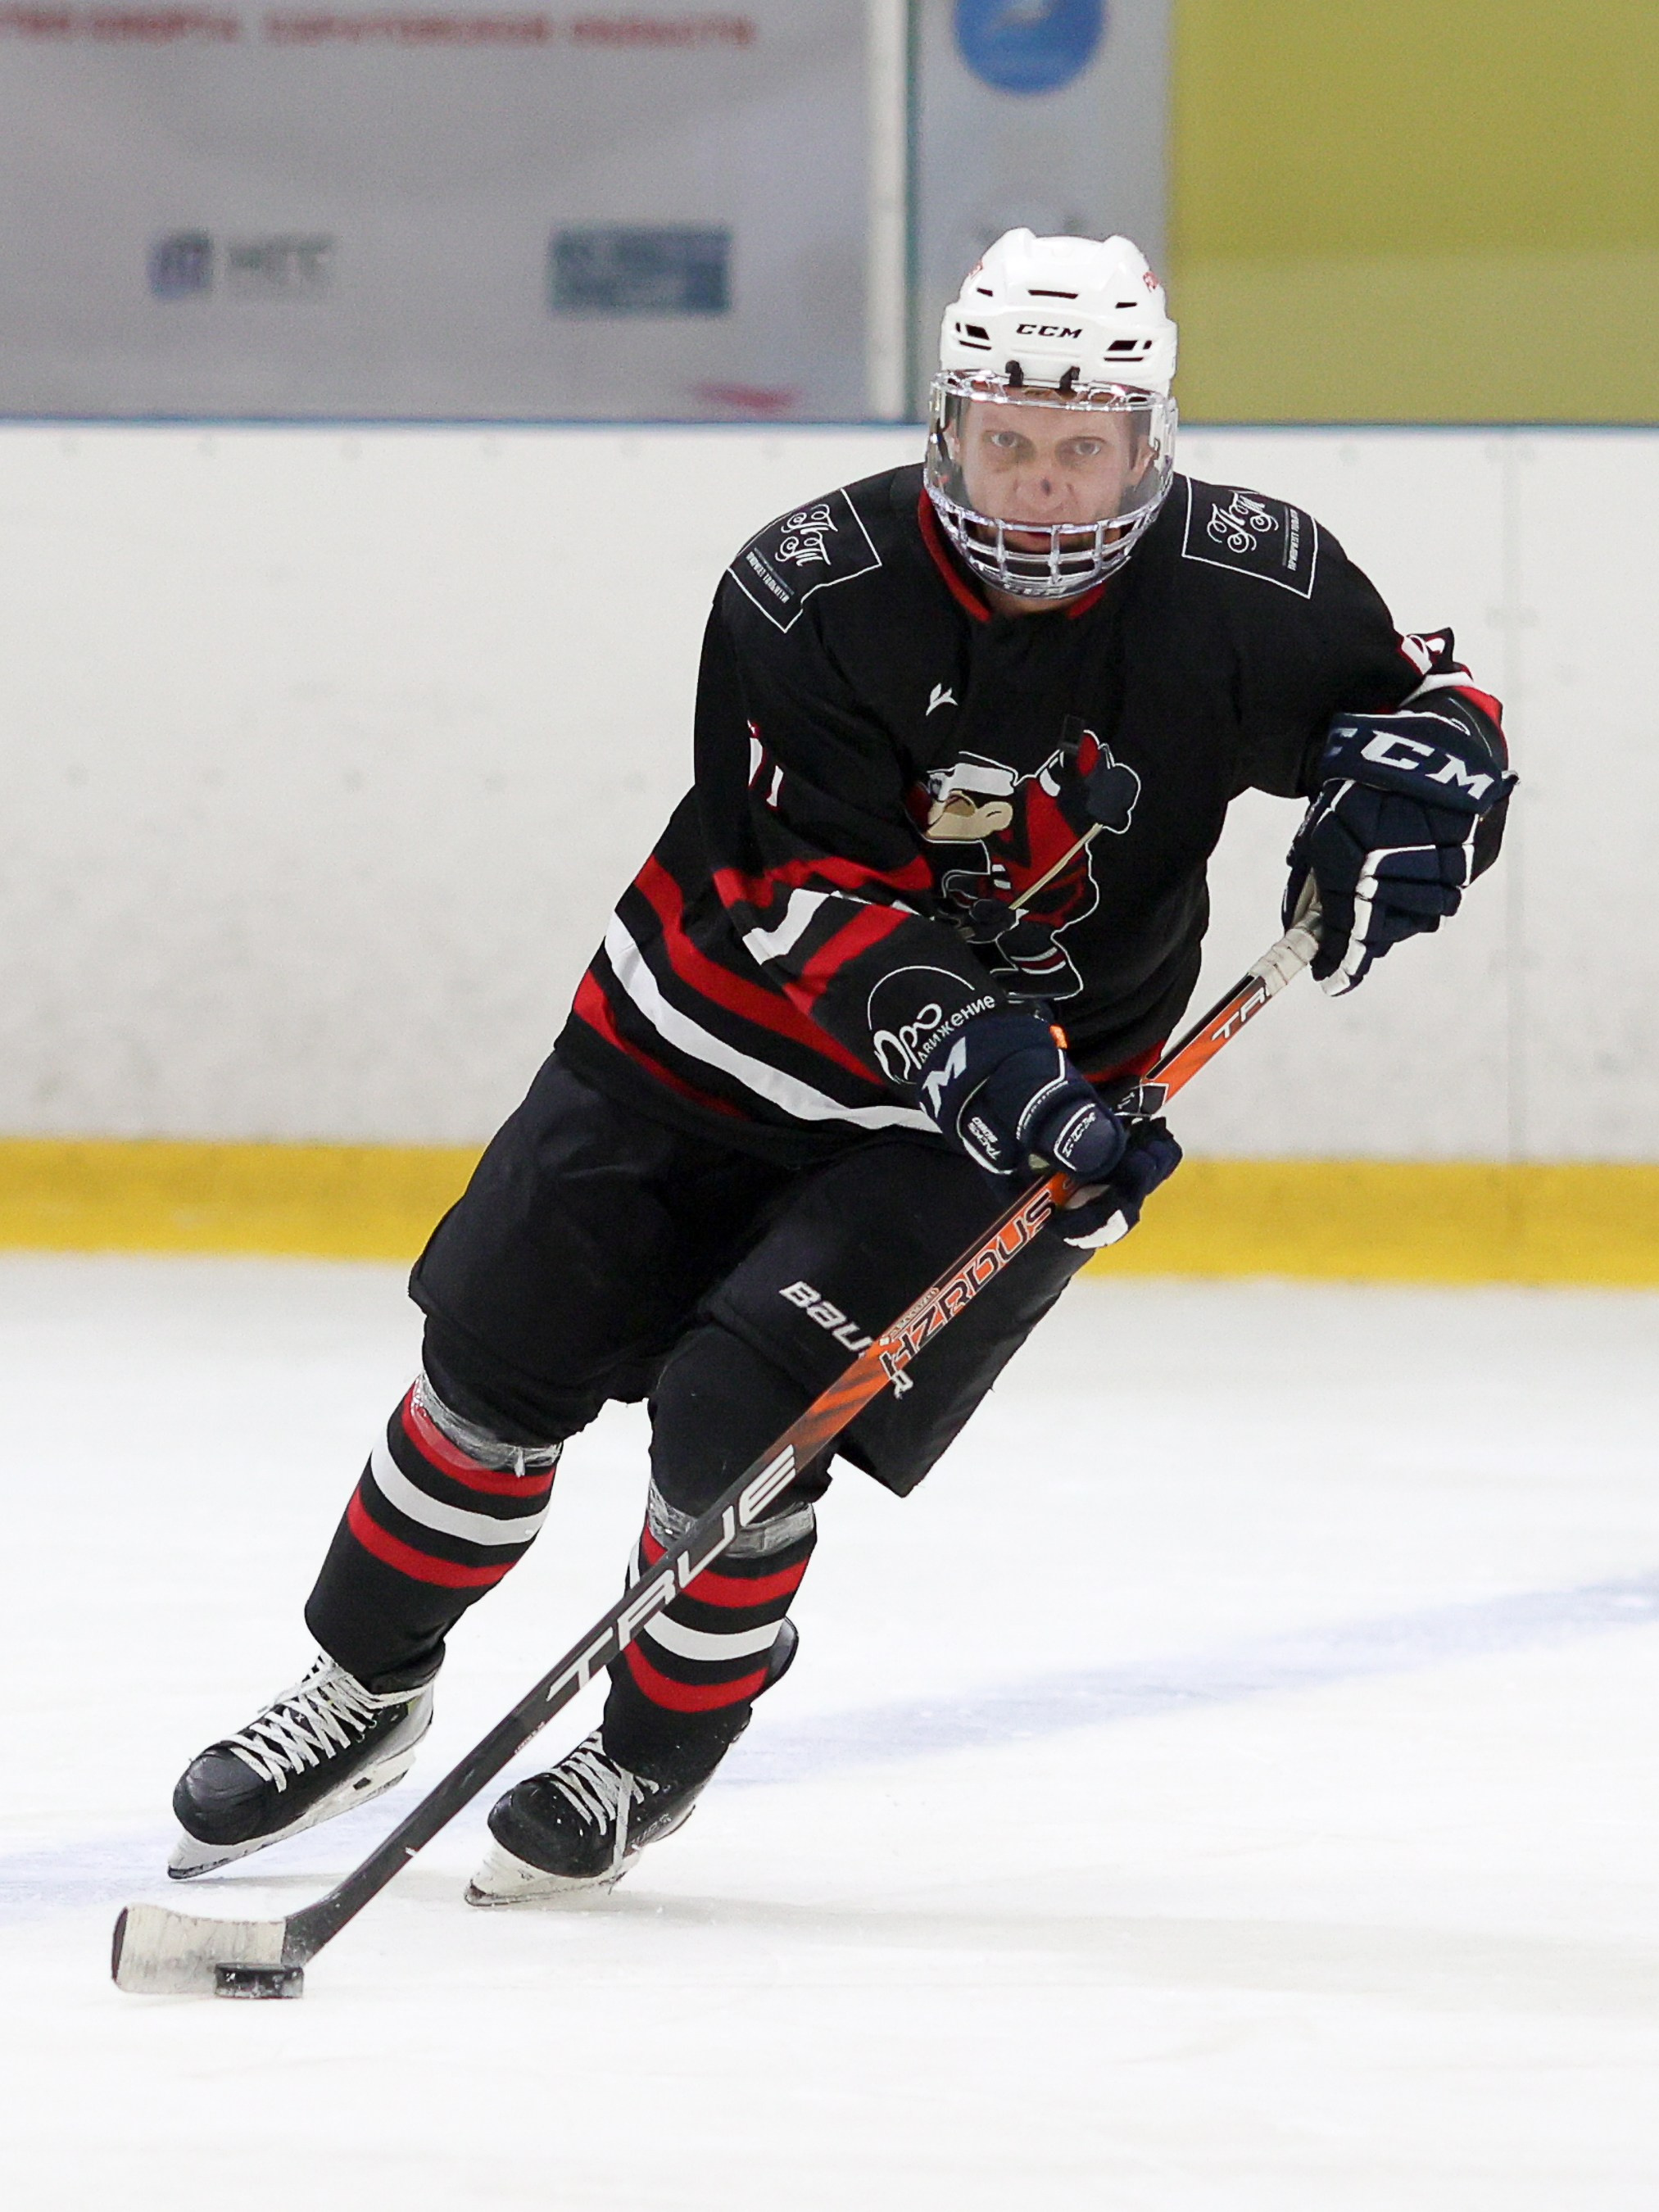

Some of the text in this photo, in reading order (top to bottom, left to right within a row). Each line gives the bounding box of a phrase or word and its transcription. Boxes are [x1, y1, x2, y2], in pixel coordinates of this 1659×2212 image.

[1016, 323, 1082, 338] CCM
[778, 1281, 914, 1399] BAUR
[878, 1189, 1057, 1380] HZRDUS
[546, 1444, 797, 1702] TRUE
